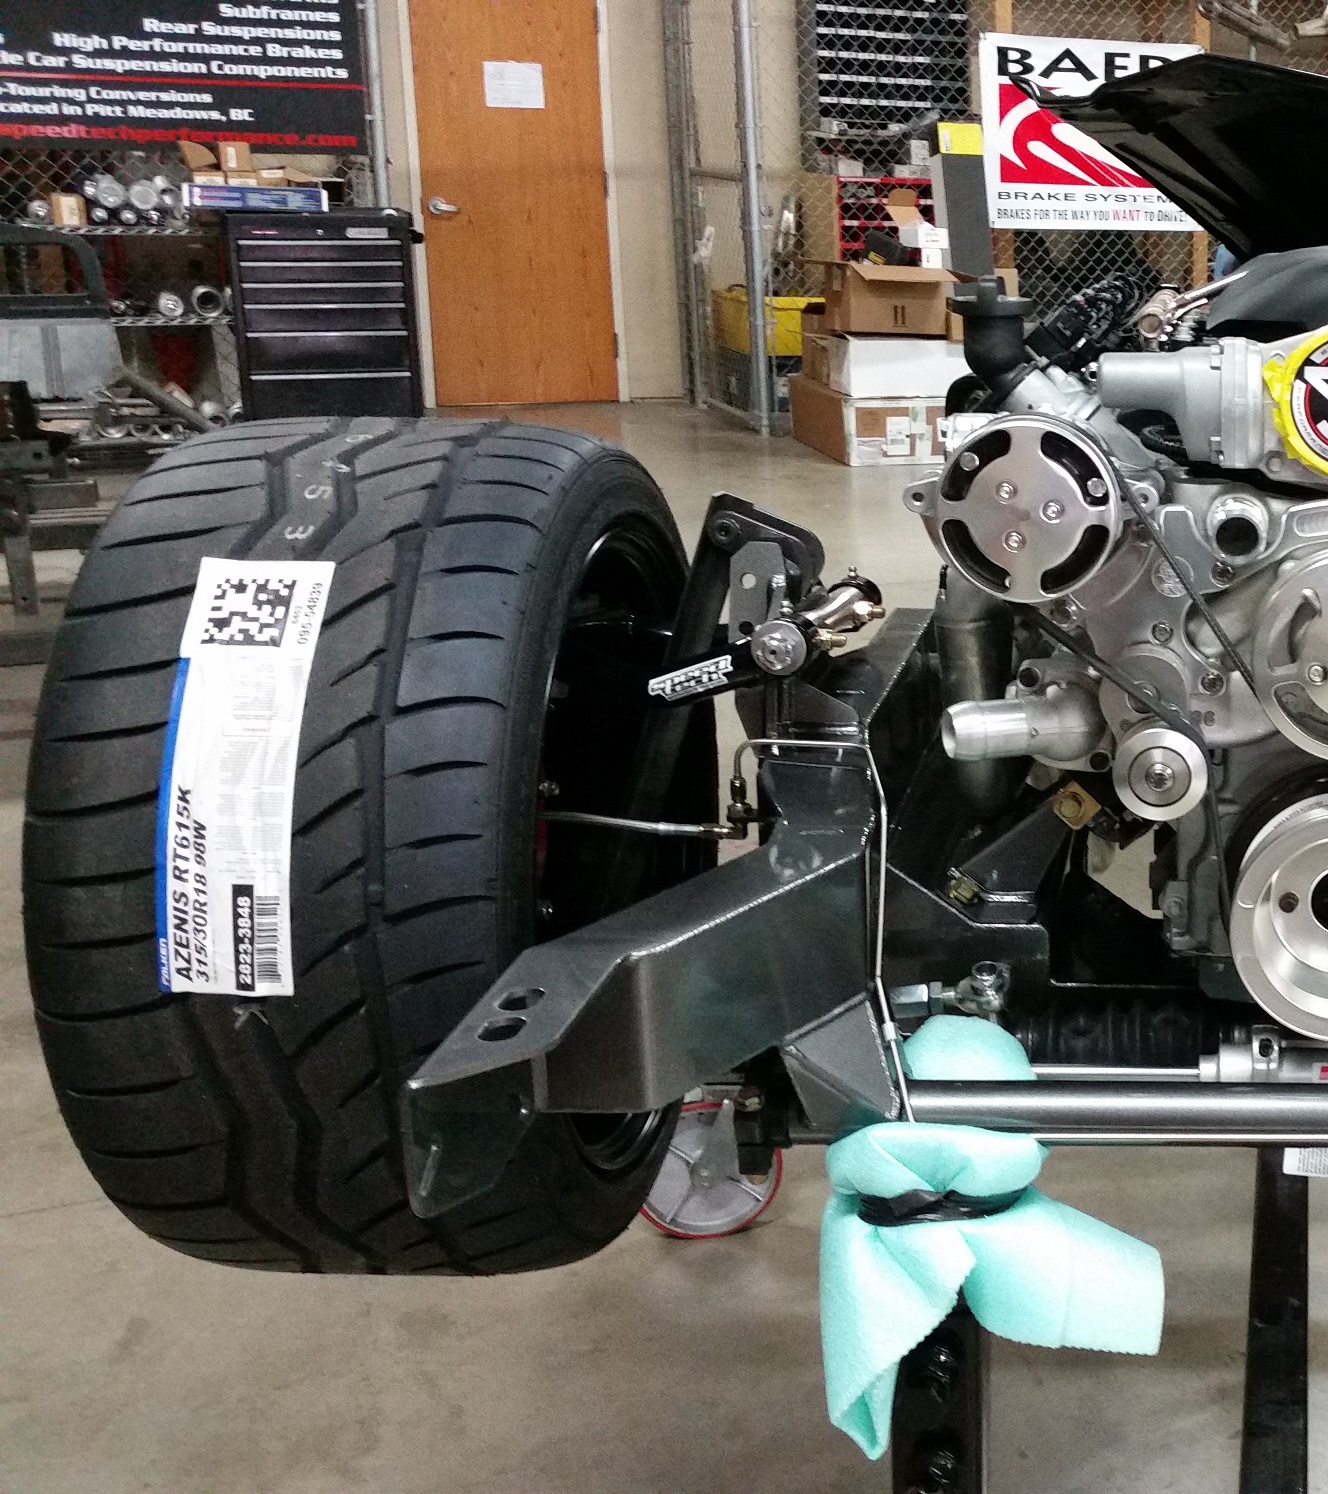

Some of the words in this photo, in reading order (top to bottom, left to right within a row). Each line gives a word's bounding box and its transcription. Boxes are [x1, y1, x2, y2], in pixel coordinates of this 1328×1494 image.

[218, 3, 341, 22] Subframes
[142, 17, 199, 35] Rear
[201, 21, 342, 41] Suspensions
[51, 31, 109, 52] High
[111, 35, 263, 57] Performance
[265, 43, 344, 60] Brakes
[26, 51, 69, 68] Car
[70, 53, 208, 74] Suspension
[209, 60, 349, 79] Components
[88, 86, 213, 103] Conversions
[61, 102, 83, 116] in
[85, 103, 126, 117] Pitt
[126, 105, 227, 123] Meadows,
[229, 108, 255, 121] BC
[997, 191, 1077, 202] BRAKE
[997, 208, 1031, 220] BRAKES
[1034, 209, 1051, 220] FOR
[1053, 209, 1068, 220] THE
[1071, 209, 1090, 221] WAY
[1094, 209, 1110, 221] YOU
[1112, 208, 1141, 222] WANT
[1144, 210, 1155, 222] TO
[172, 784, 192, 884] RT615K
[192, 818, 208, 868] 98W
[172, 889, 195, 983] AZENIS
[191, 872, 210, 983] 315/30R18
[236, 896, 254, 987] 2823-3848
